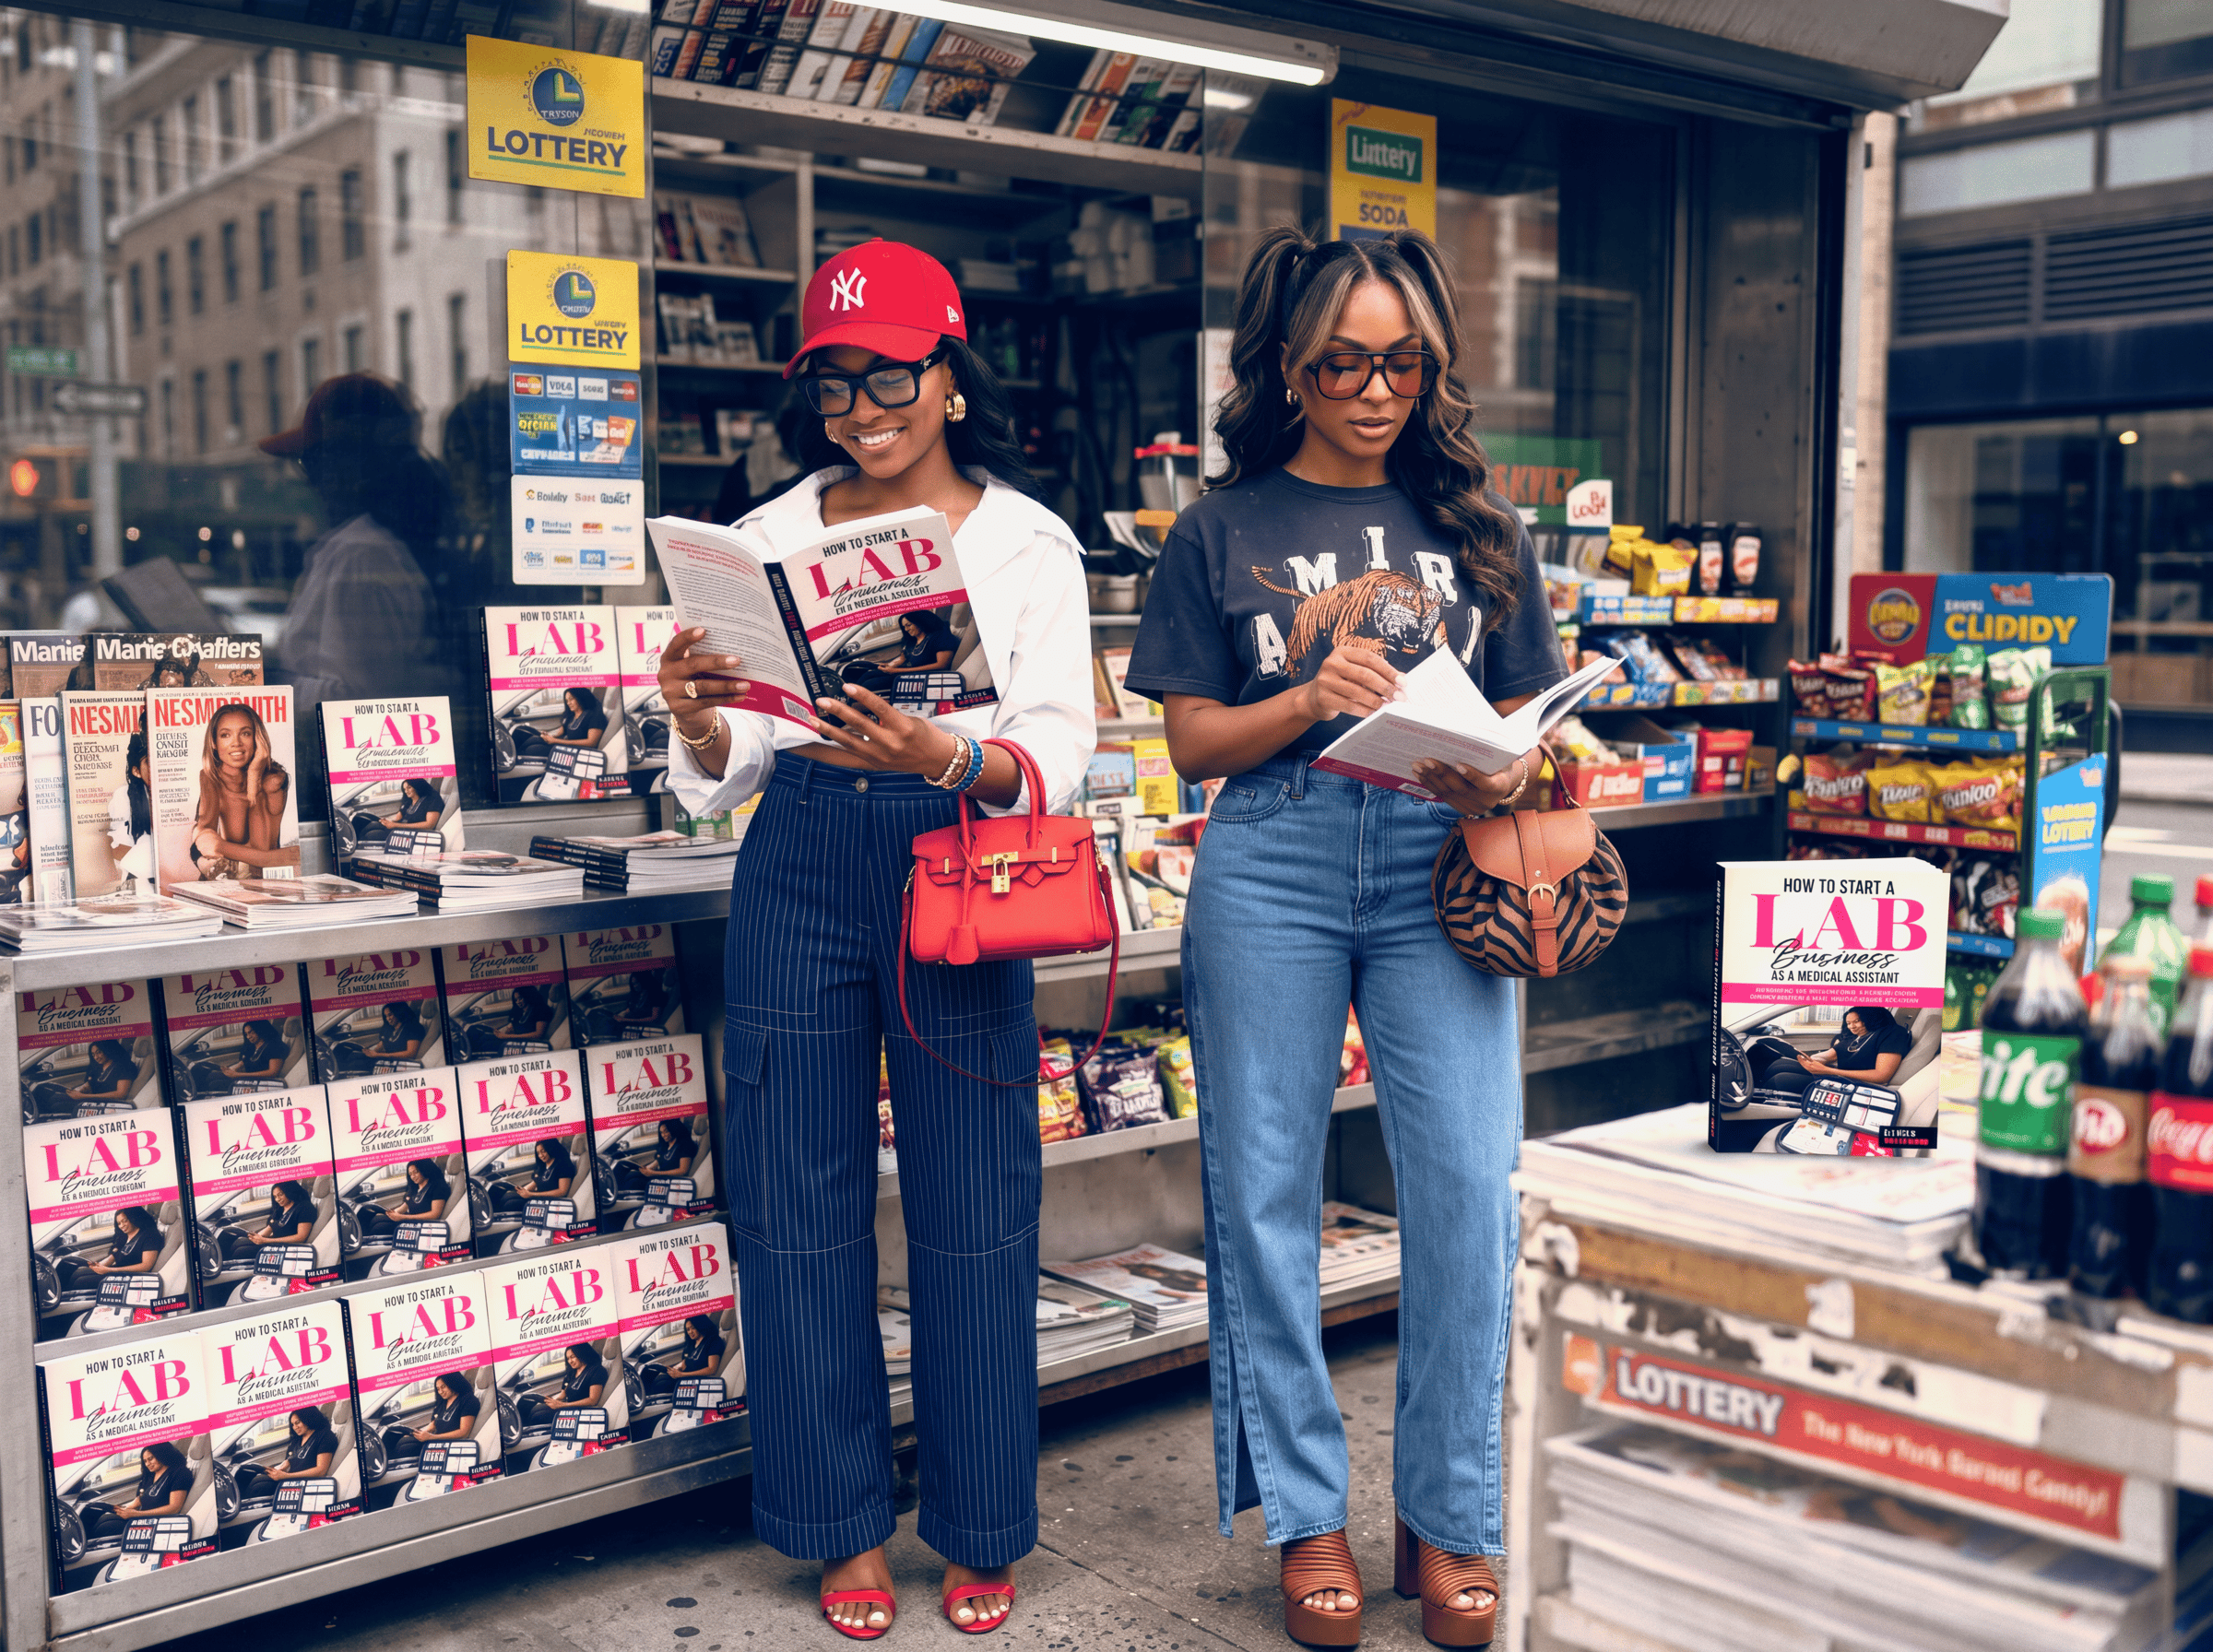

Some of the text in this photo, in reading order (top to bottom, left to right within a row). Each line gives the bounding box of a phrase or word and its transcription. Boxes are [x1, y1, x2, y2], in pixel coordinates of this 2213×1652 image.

[488, 126, 627, 168] LOTTERY
[1359, 203, 1408, 227] SODA
[522, 323, 628, 349] LOTTERY
[822, 528, 909, 558] HOW TO START A
[806, 538, 942, 601] LAB
[520, 611, 585, 621] HOW TO START A
[646, 611, 674, 620] HOW TO
[504, 622, 605, 656] LAB
[355, 705, 373, 714] HOW
[375, 704, 385, 714] TO
[414, 703, 420, 712] A
[339, 714, 441, 749] LAB
[1783, 879, 1895, 895] HOW TO START A
[1749, 893, 1927, 951] LAB
[1770, 938, 1899, 970] Business
[1771, 970, 1899, 984] AS A MEDICAL ASSISTANT
[20, 981, 135, 1013] LAB
[50, 1022, 55, 1031] A
[56, 1020, 86, 1030] MEDICAL
[616, 1044, 674, 1059] HOW TO START A
[490, 1060, 551, 1077] HOW TO START A
[601, 1053, 693, 1096] LAB
[361, 1077, 426, 1095] HOW TO START A
[474, 1069, 572, 1115] LAB
[222, 1096, 292, 1115] HOW TO START A
[344, 1087, 447, 1134] LAB
[60, 1119, 136, 1140] HOW TO START A
[204, 1107, 315, 1157] LAB
[40, 1129, 161, 1183] LAB
[639, 1234, 700, 1255] HOW TO START A
[517, 1259, 582, 1280] HOW TO START A
[625, 1244, 720, 1293] LAB
[385, 1285, 455, 1308] HOW TO START A
[502, 1268, 604, 1321] LAB
[235, 1316, 309, 1341] HOW TO START A
[367, 1294, 476, 1350] LAB
[86, 1349, 164, 1375] HOW TO START A
[217, 1326, 333, 1386] LAB
[65, 1359, 191, 1421] LAB
[248, 1393, 254, 1402] A
[255, 1387, 285, 1400] MEDICAL
[1616, 1356, 1784, 1435] LOTTERY
[86, 1432, 97, 1442] AS
[99, 1430, 104, 1438] A
[106, 1422, 137, 1437] MEDICAL
